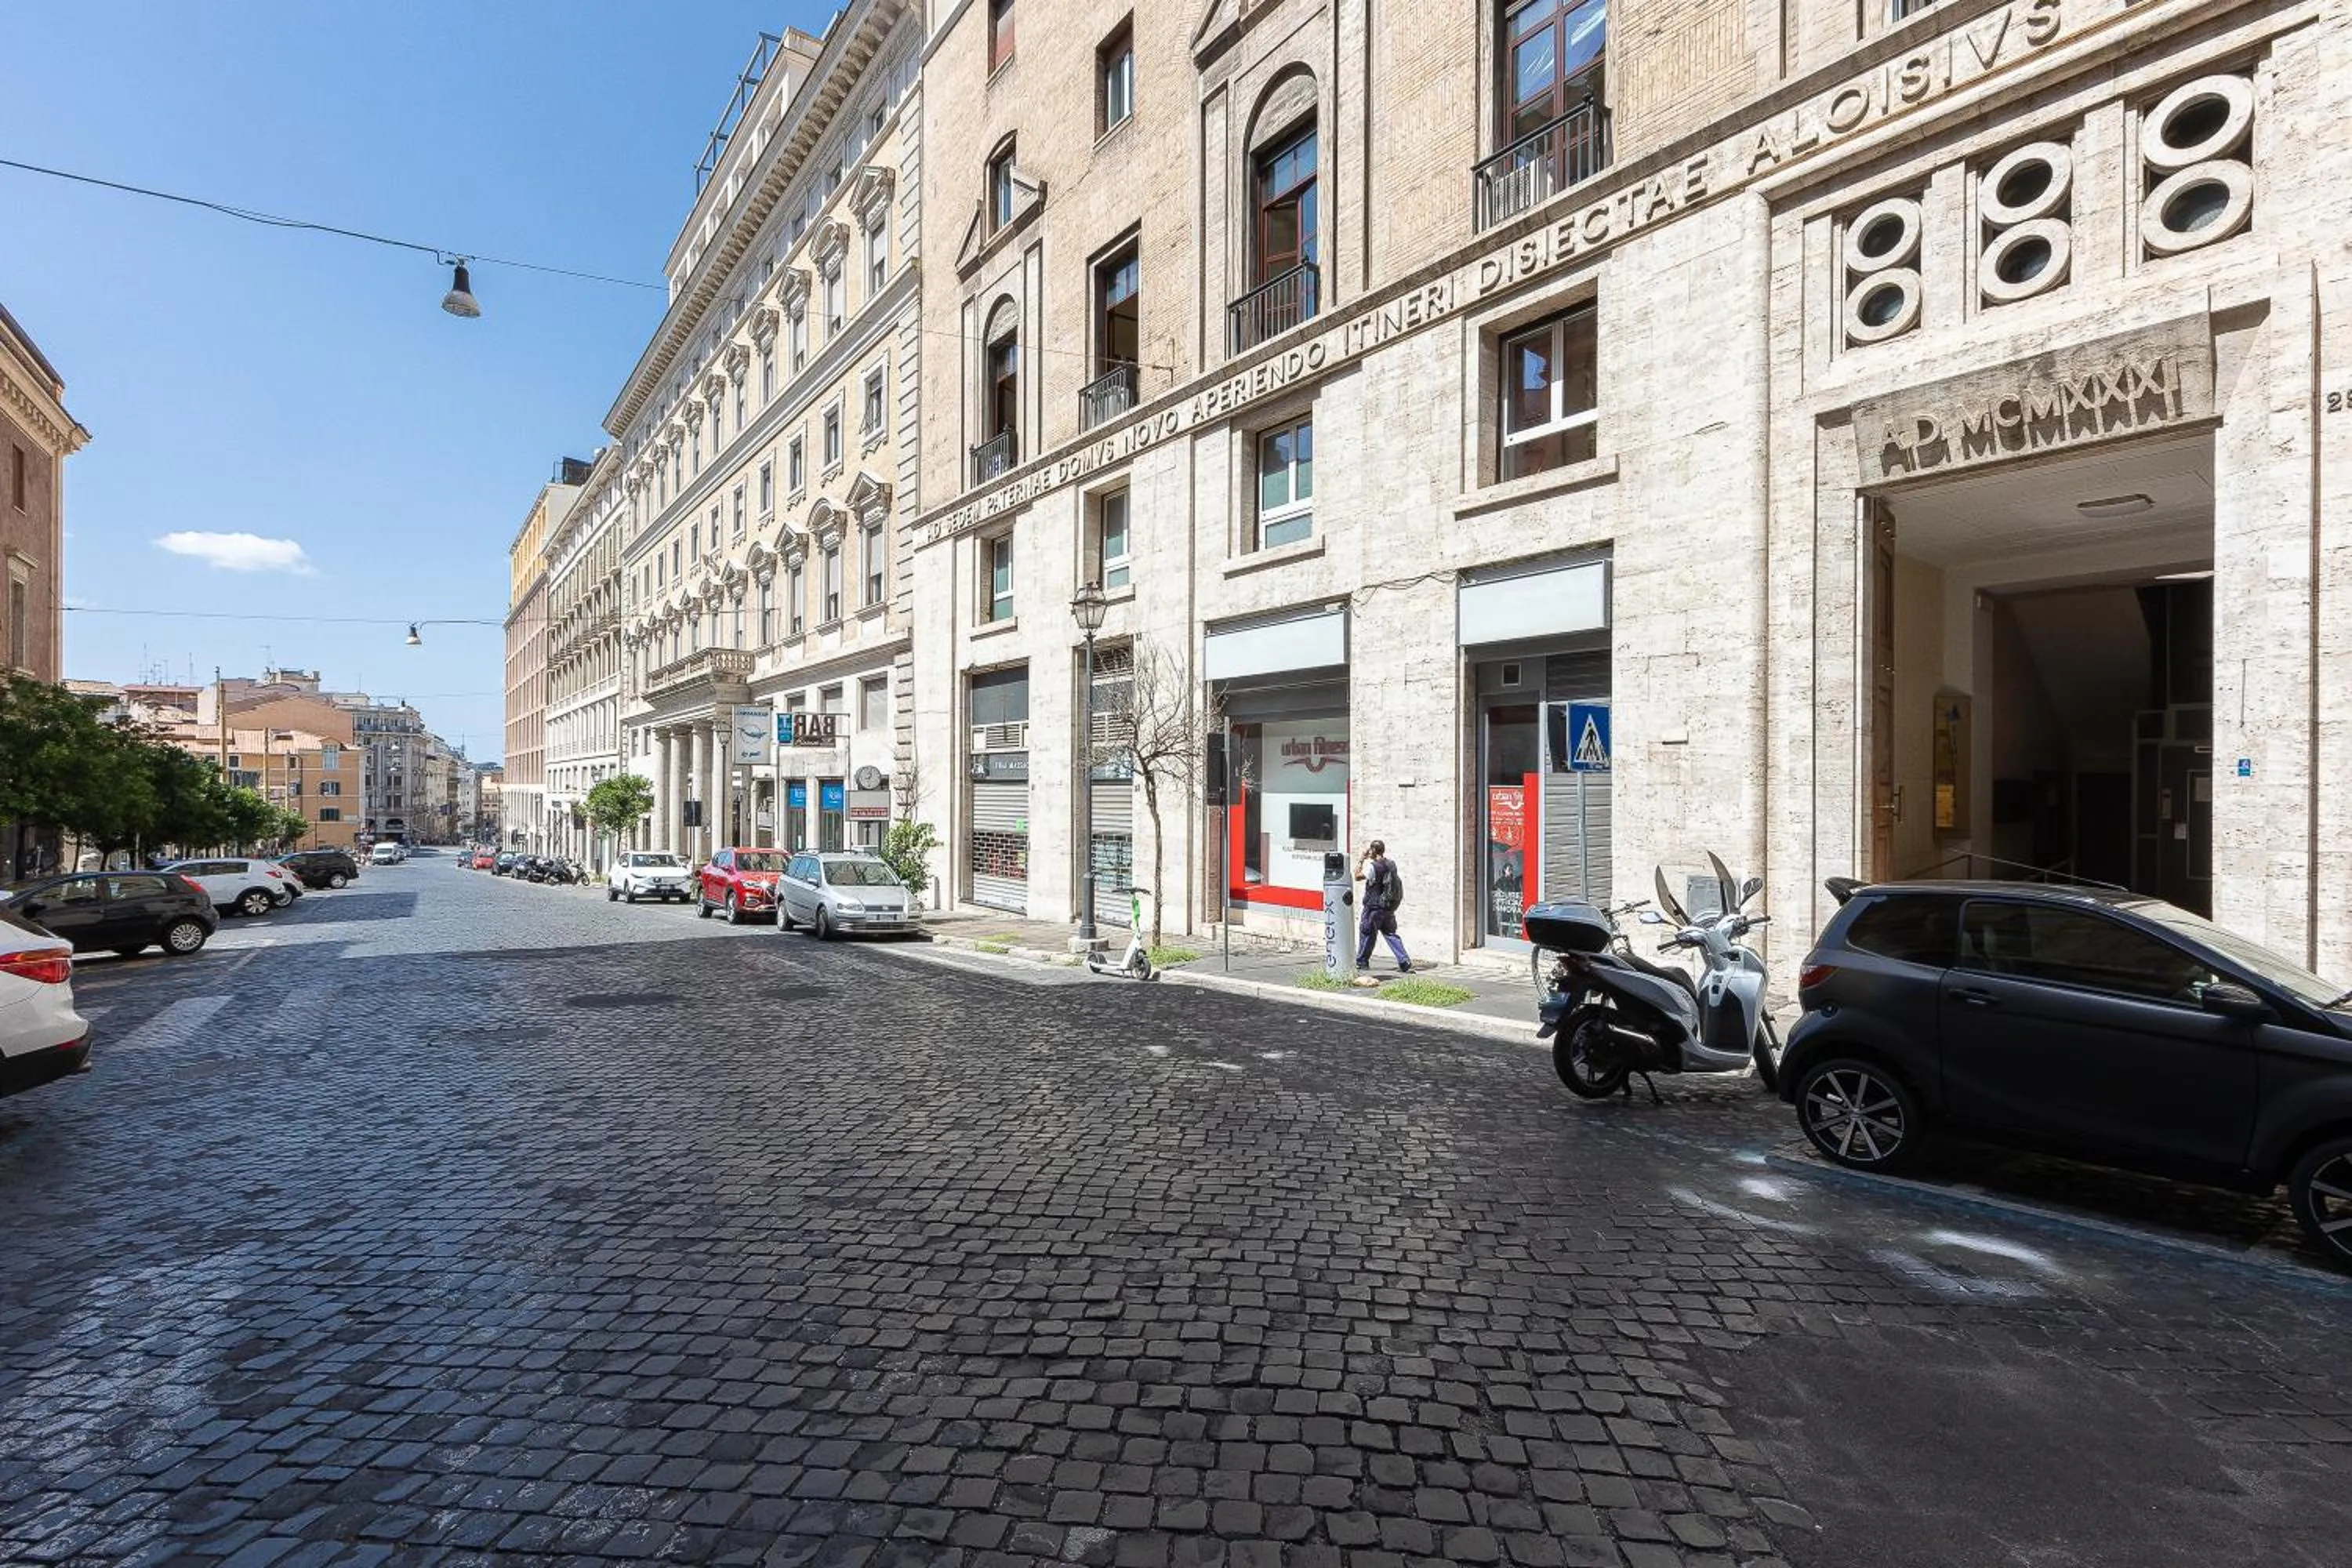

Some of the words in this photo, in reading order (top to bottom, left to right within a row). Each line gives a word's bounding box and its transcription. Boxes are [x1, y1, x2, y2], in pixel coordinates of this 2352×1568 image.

[947, 503, 981, 533] SEDEM
[987, 467, 1051, 514] PATERNAE
[1059, 440, 1114, 483] DOMVS
[1124, 409, 1179, 453] NOVO
[1192, 342, 1327, 423] APERIENDO
[1344, 275, 1455, 356] ITINERI
[1479, 153, 1709, 295] DISIECTAE
[1747, 0, 2062, 175] ALOISIVS
